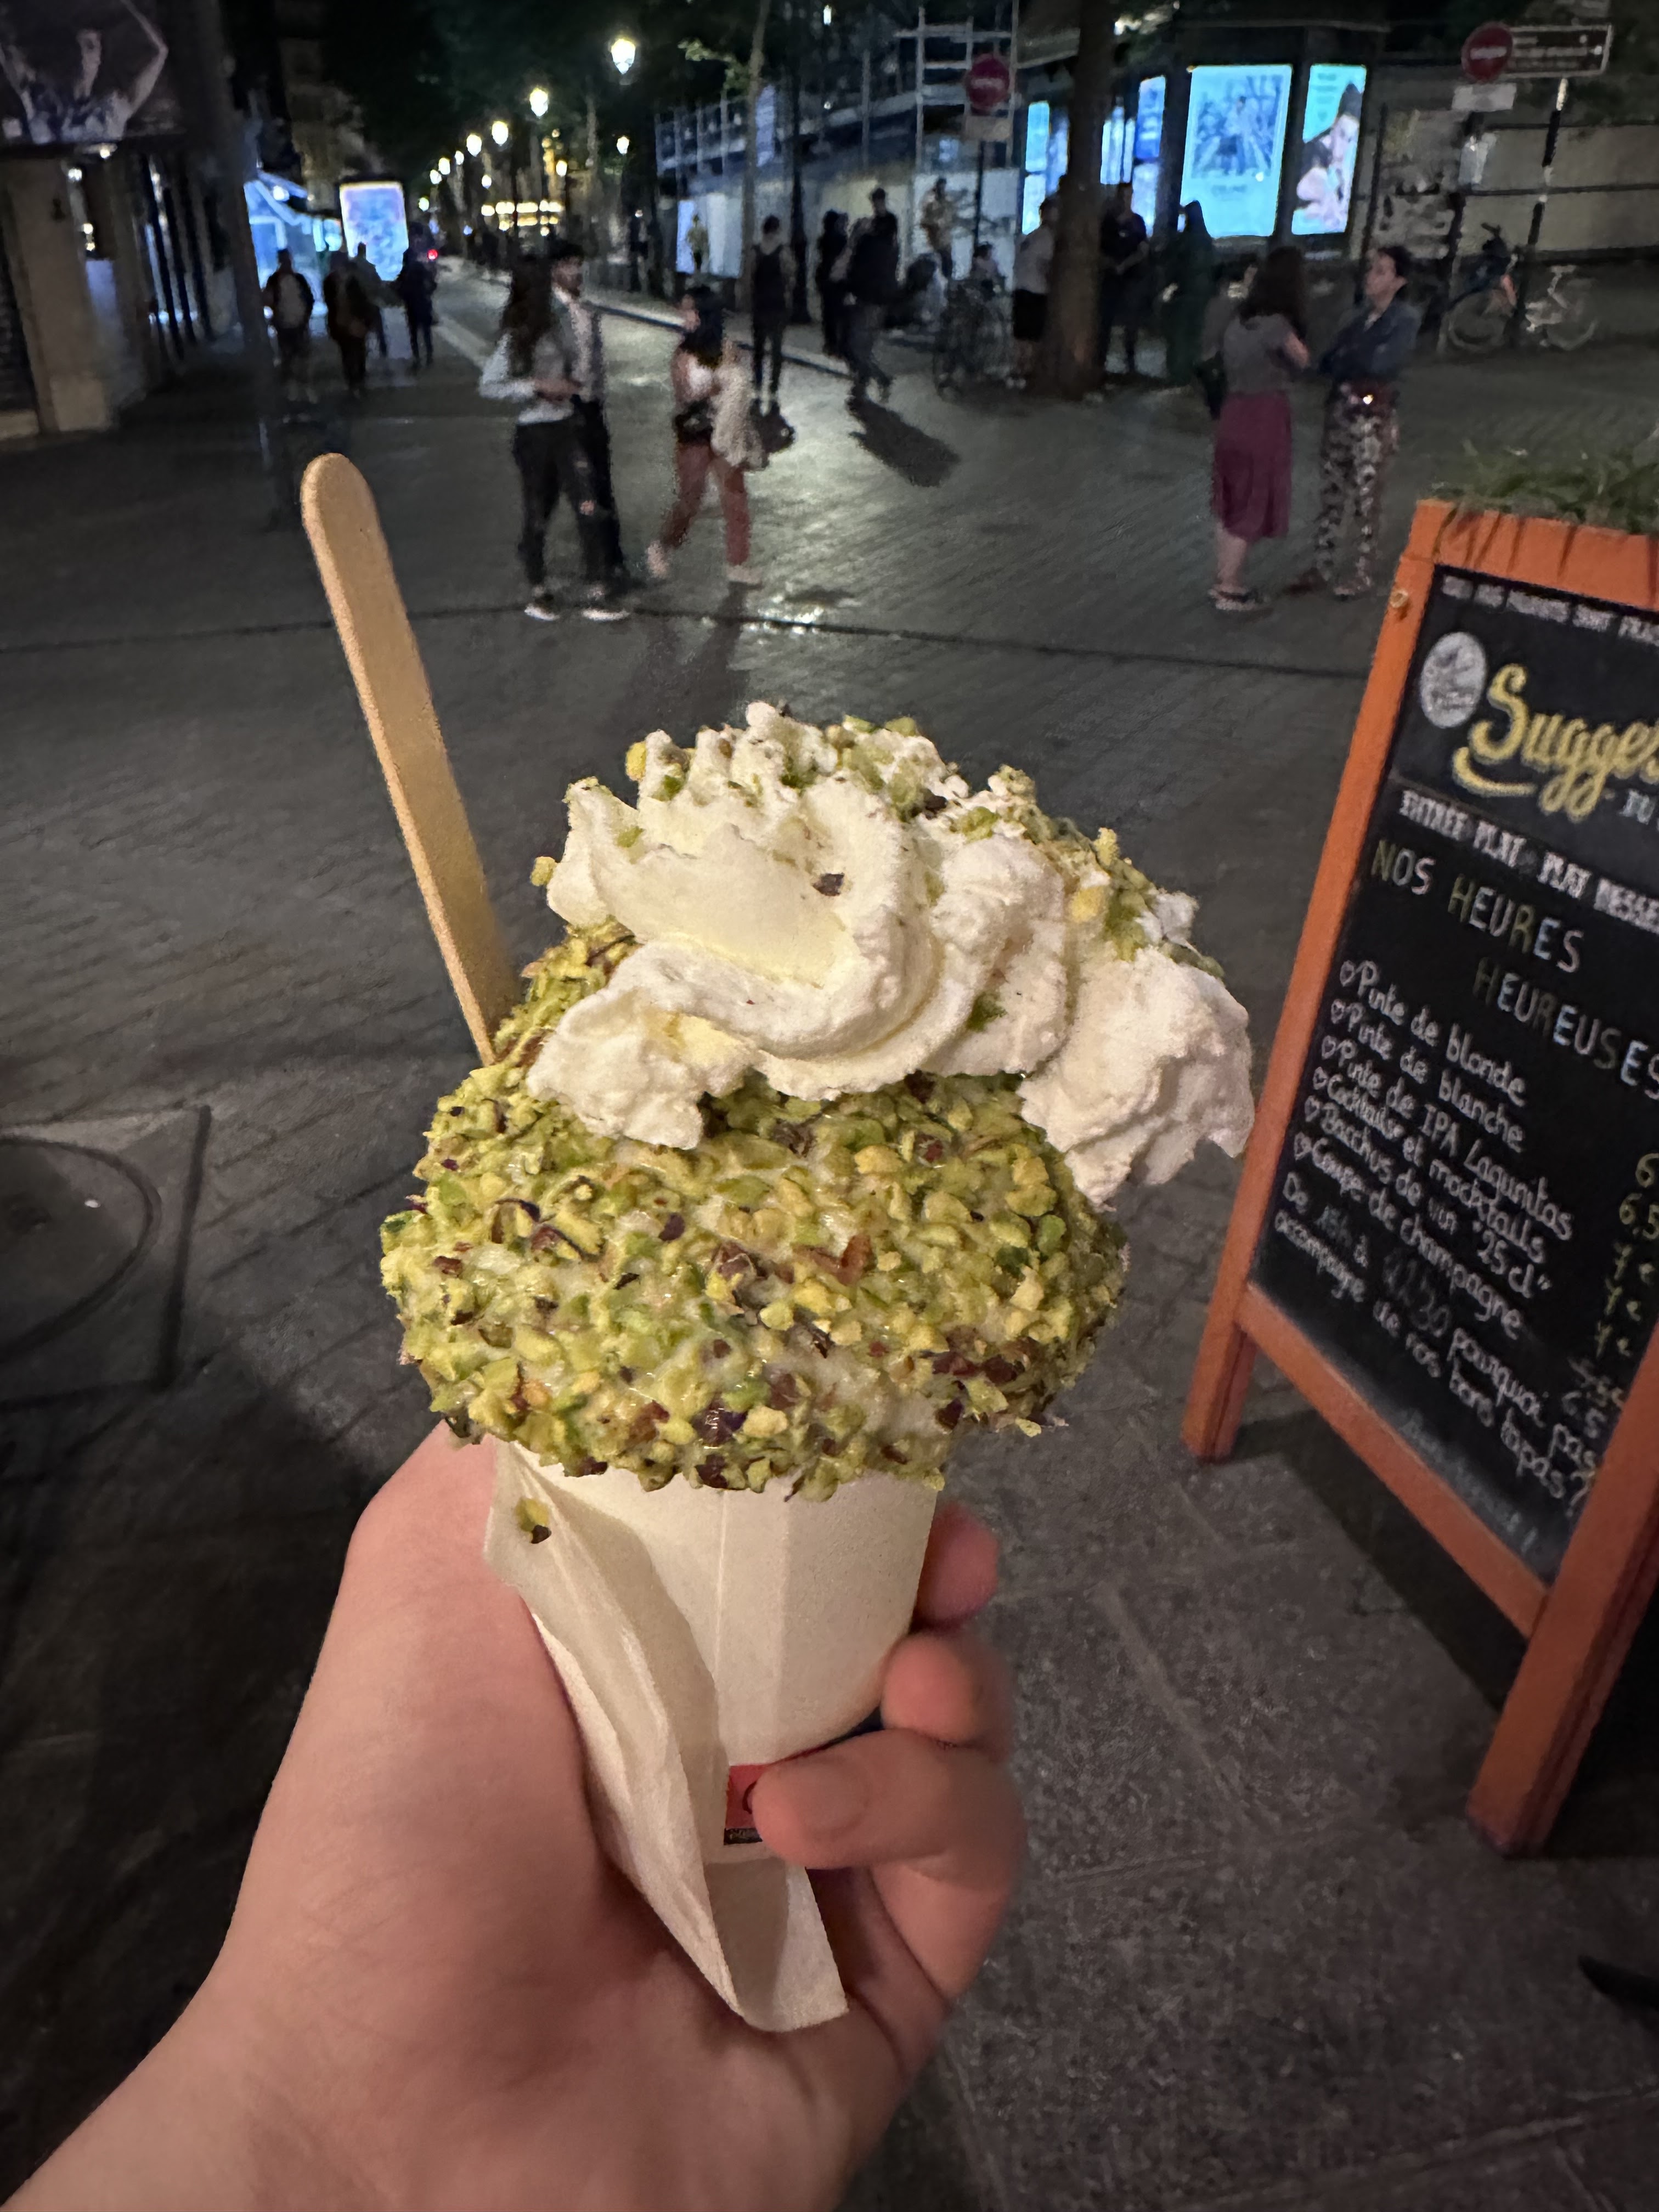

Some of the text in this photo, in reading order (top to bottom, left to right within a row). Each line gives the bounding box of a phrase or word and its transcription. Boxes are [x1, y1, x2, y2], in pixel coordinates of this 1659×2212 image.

[1372, 839, 1584, 973] NOS HEURES
[1347, 1001, 1525, 1153] Pinte de blanche
[1356, 960, 1526, 1108] Pinte de blonde
[1386, 1076, 1417, 1120] de
[1418, 1103, 1460, 1158] IPA
[1463, 1138, 1573, 1241] Lagunitas
[1395, 1167, 1424, 1207] de
[1402, 1135, 1425, 1167] et
[1368, 1187, 1398, 1232] de
[1400, 1212, 1523, 1340] champagne
[1447, 1327, 1549, 1427] pourquoi
